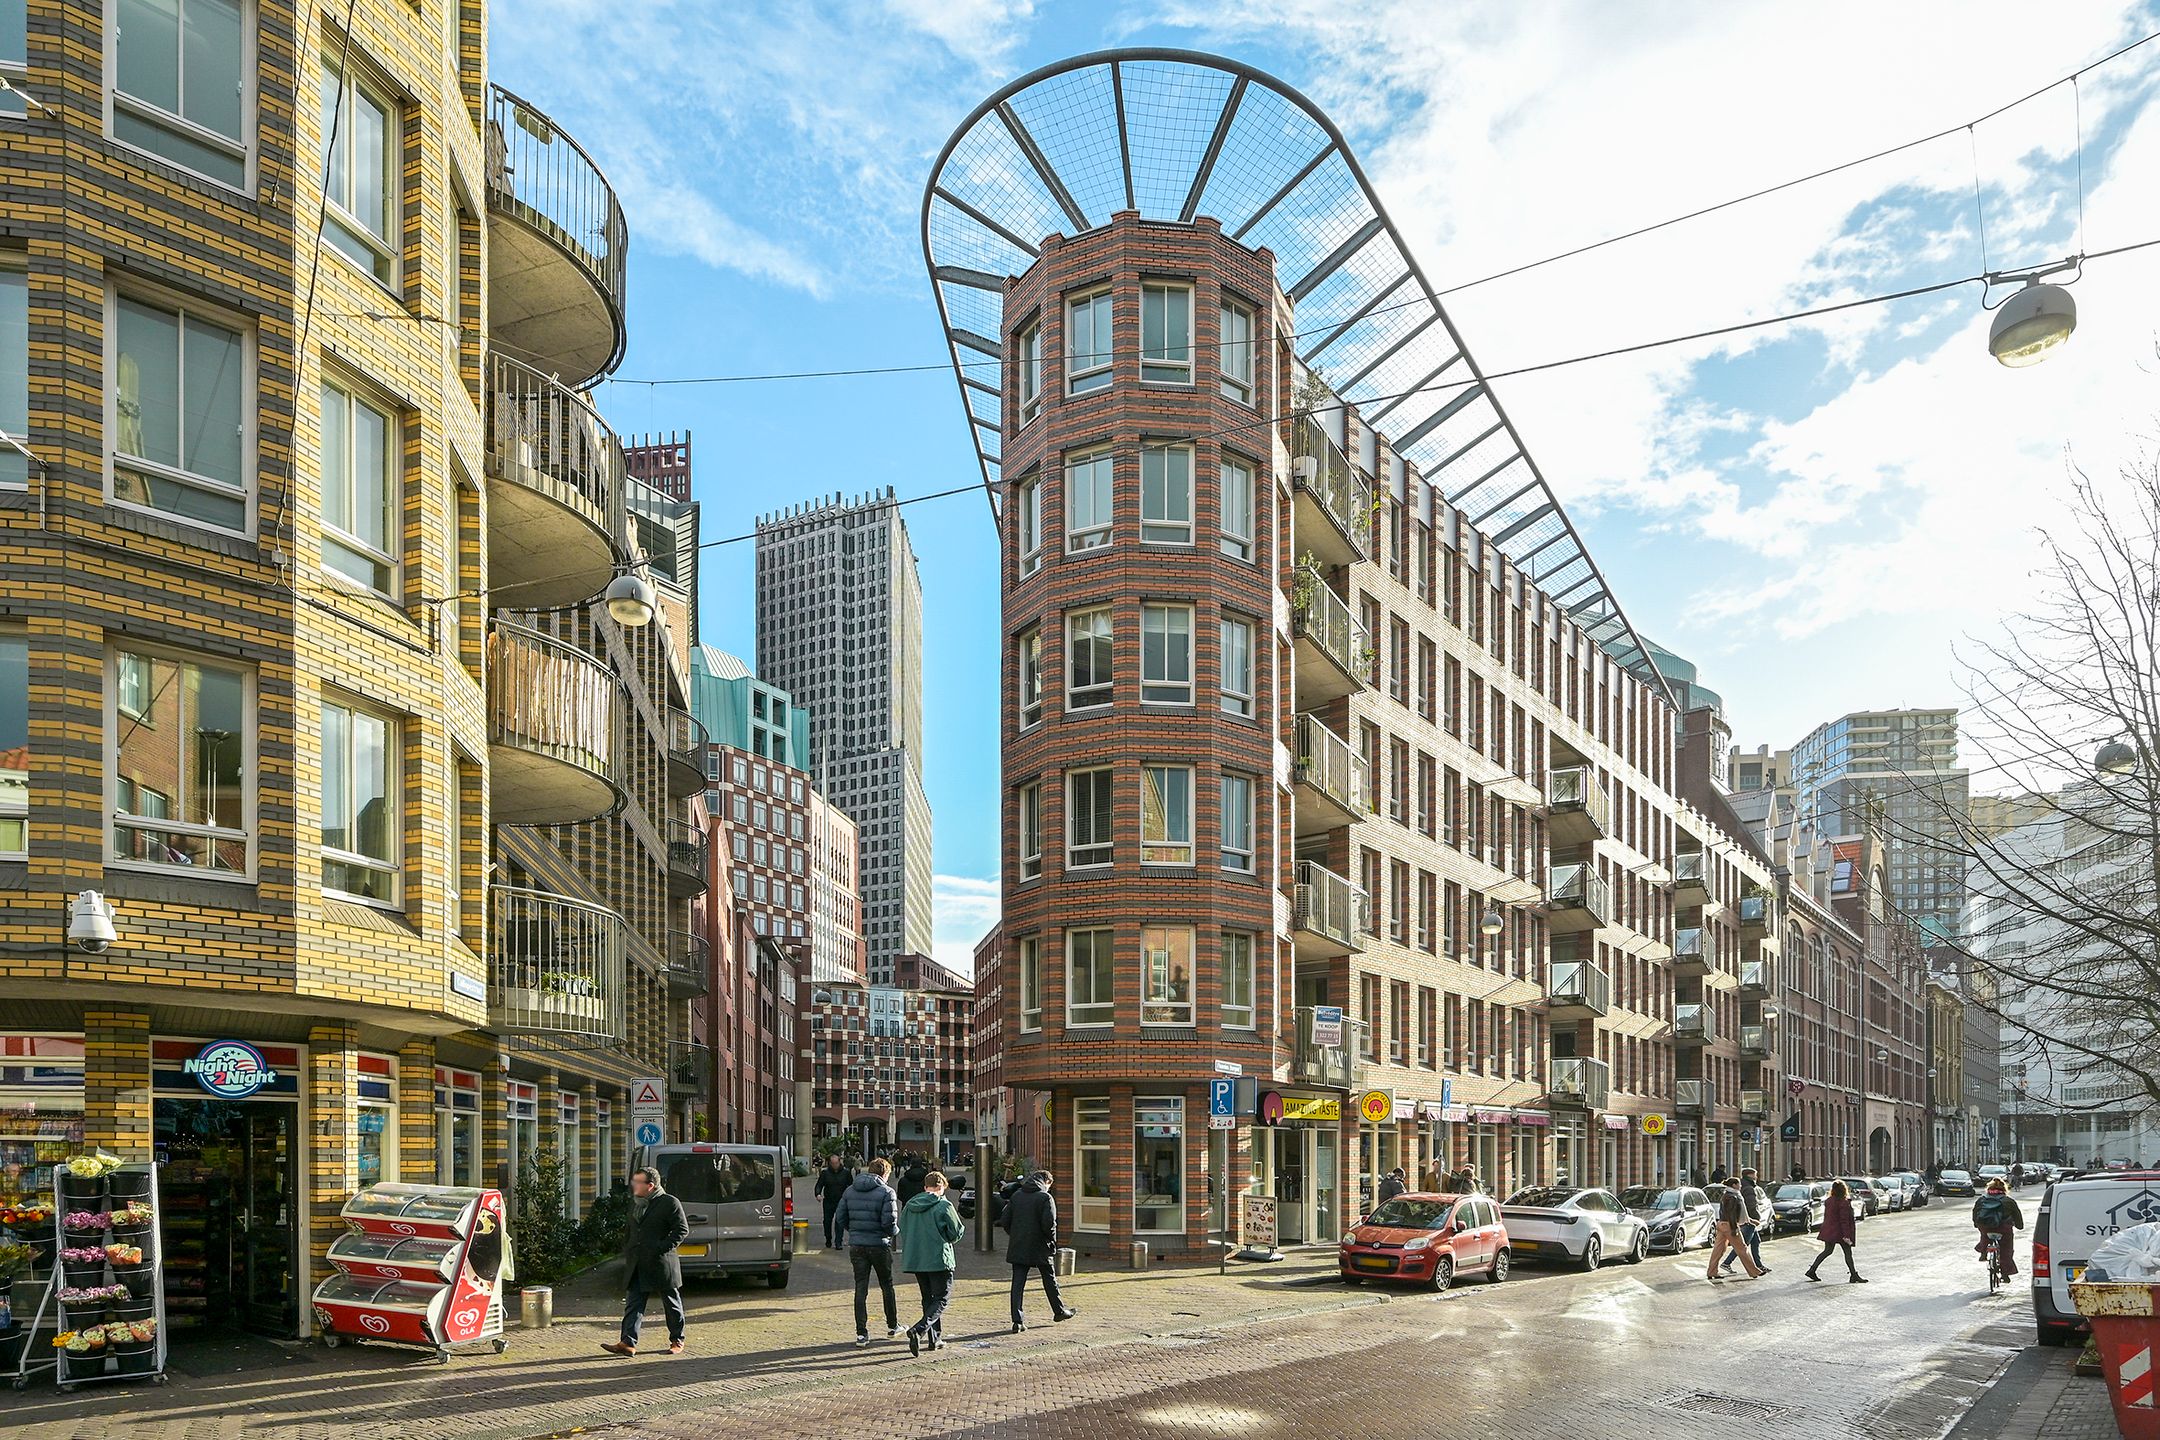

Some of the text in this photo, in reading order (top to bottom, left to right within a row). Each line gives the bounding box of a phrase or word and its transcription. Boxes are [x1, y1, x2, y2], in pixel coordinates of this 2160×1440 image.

[184, 1058, 237, 1075] Night
[213, 1070, 276, 1086] 2Night
[1217, 1082, 1229, 1101] P
[1285, 1102, 1338, 1116] AMAZING TASTE
[2085, 1225, 2132, 1236] SYR
[460, 1327, 475, 1336] OLA
